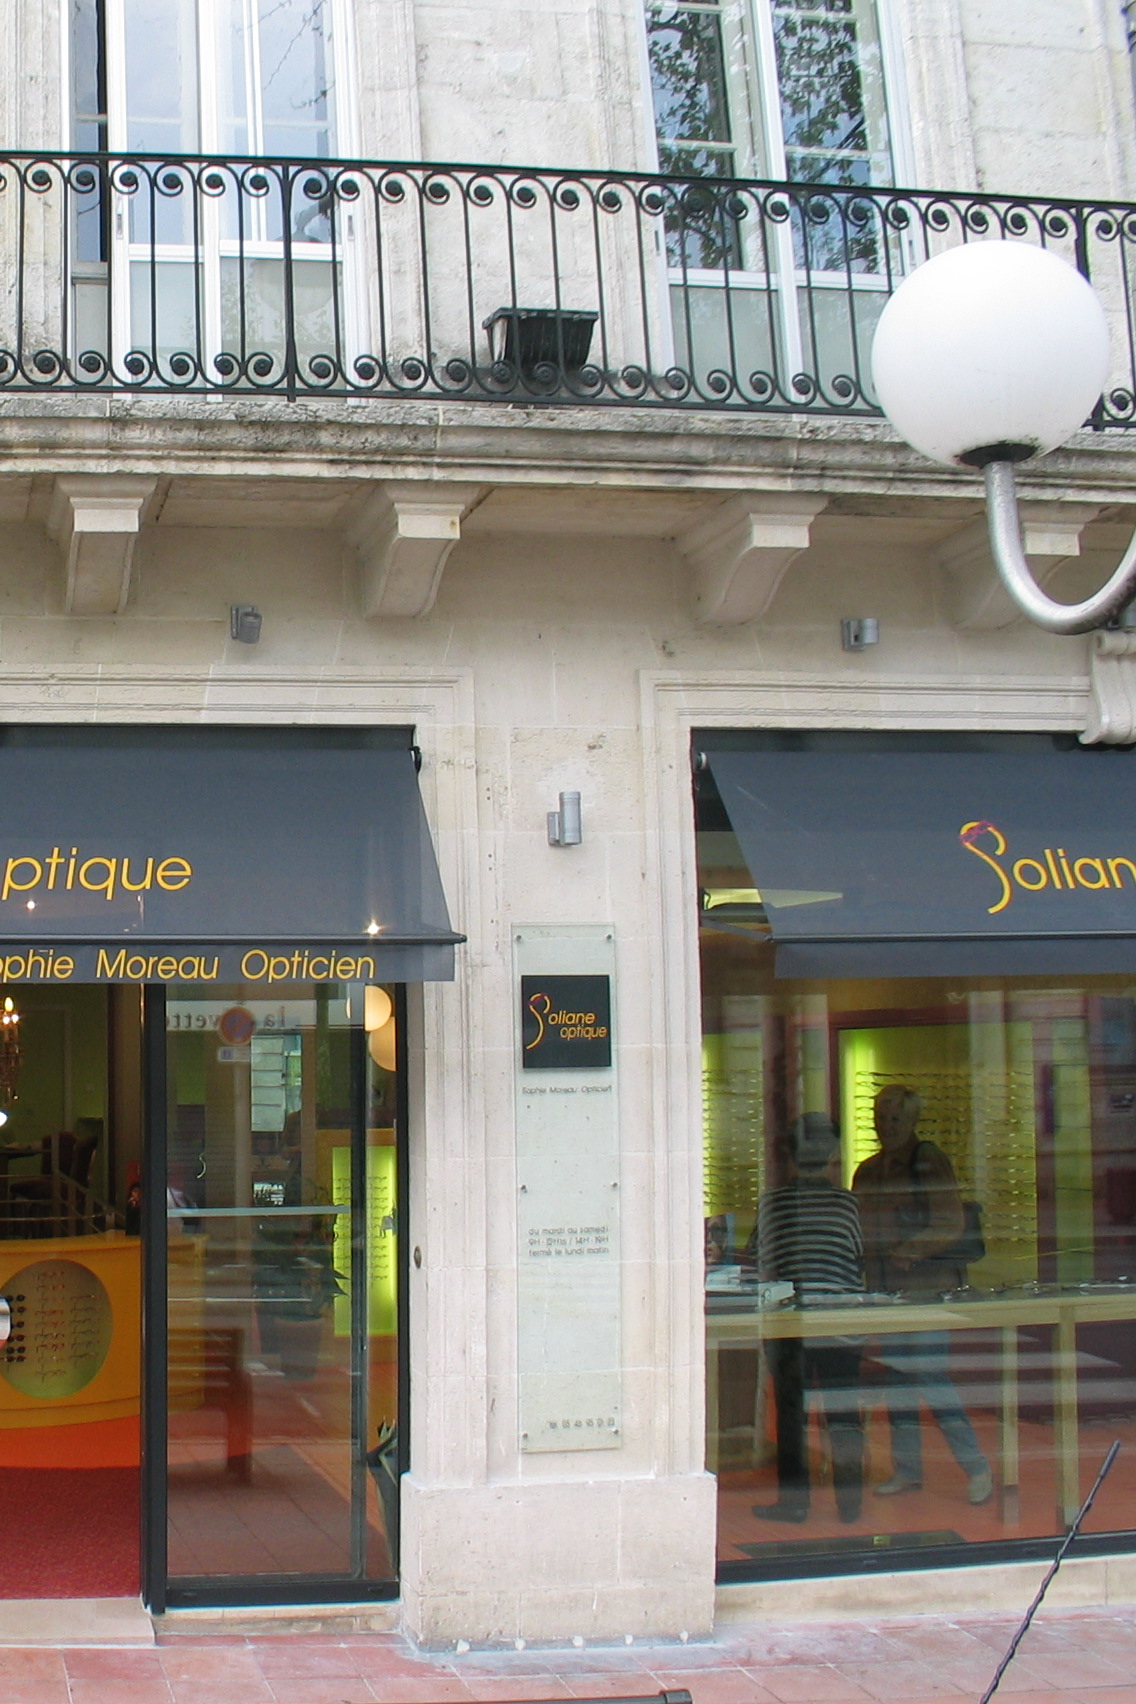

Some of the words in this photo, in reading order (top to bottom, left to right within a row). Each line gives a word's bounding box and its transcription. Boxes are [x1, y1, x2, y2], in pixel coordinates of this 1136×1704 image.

[97, 949, 219, 981] Moreau
[241, 949, 375, 982] Opticien
[526, 992, 597, 1050] Soliane
[559, 1025, 607, 1041] optique
